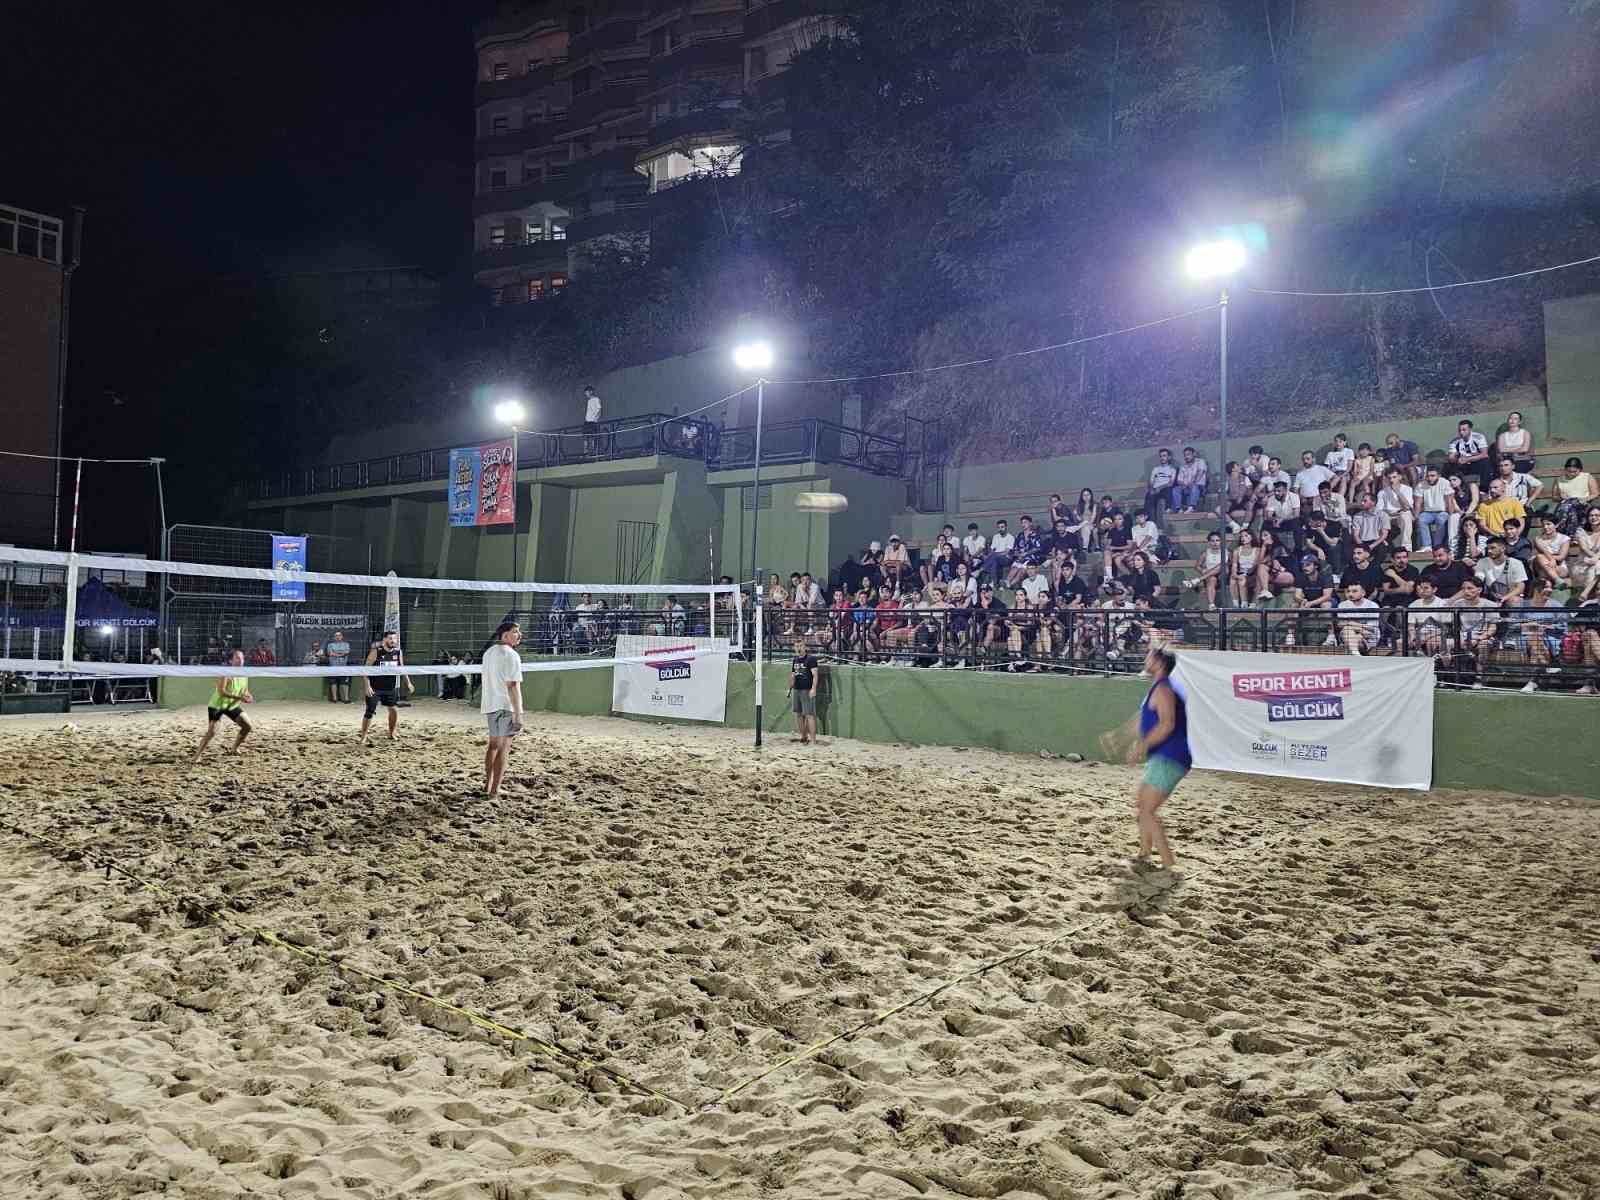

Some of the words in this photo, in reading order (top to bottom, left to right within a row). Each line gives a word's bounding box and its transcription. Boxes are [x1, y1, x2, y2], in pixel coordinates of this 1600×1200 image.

[660, 667, 690, 679] GÖLCÜK
[1238, 677, 1286, 692] SPOR
[1291, 671, 1344, 690] KENTİ
[1271, 701, 1339, 718] GÖLCÜK
